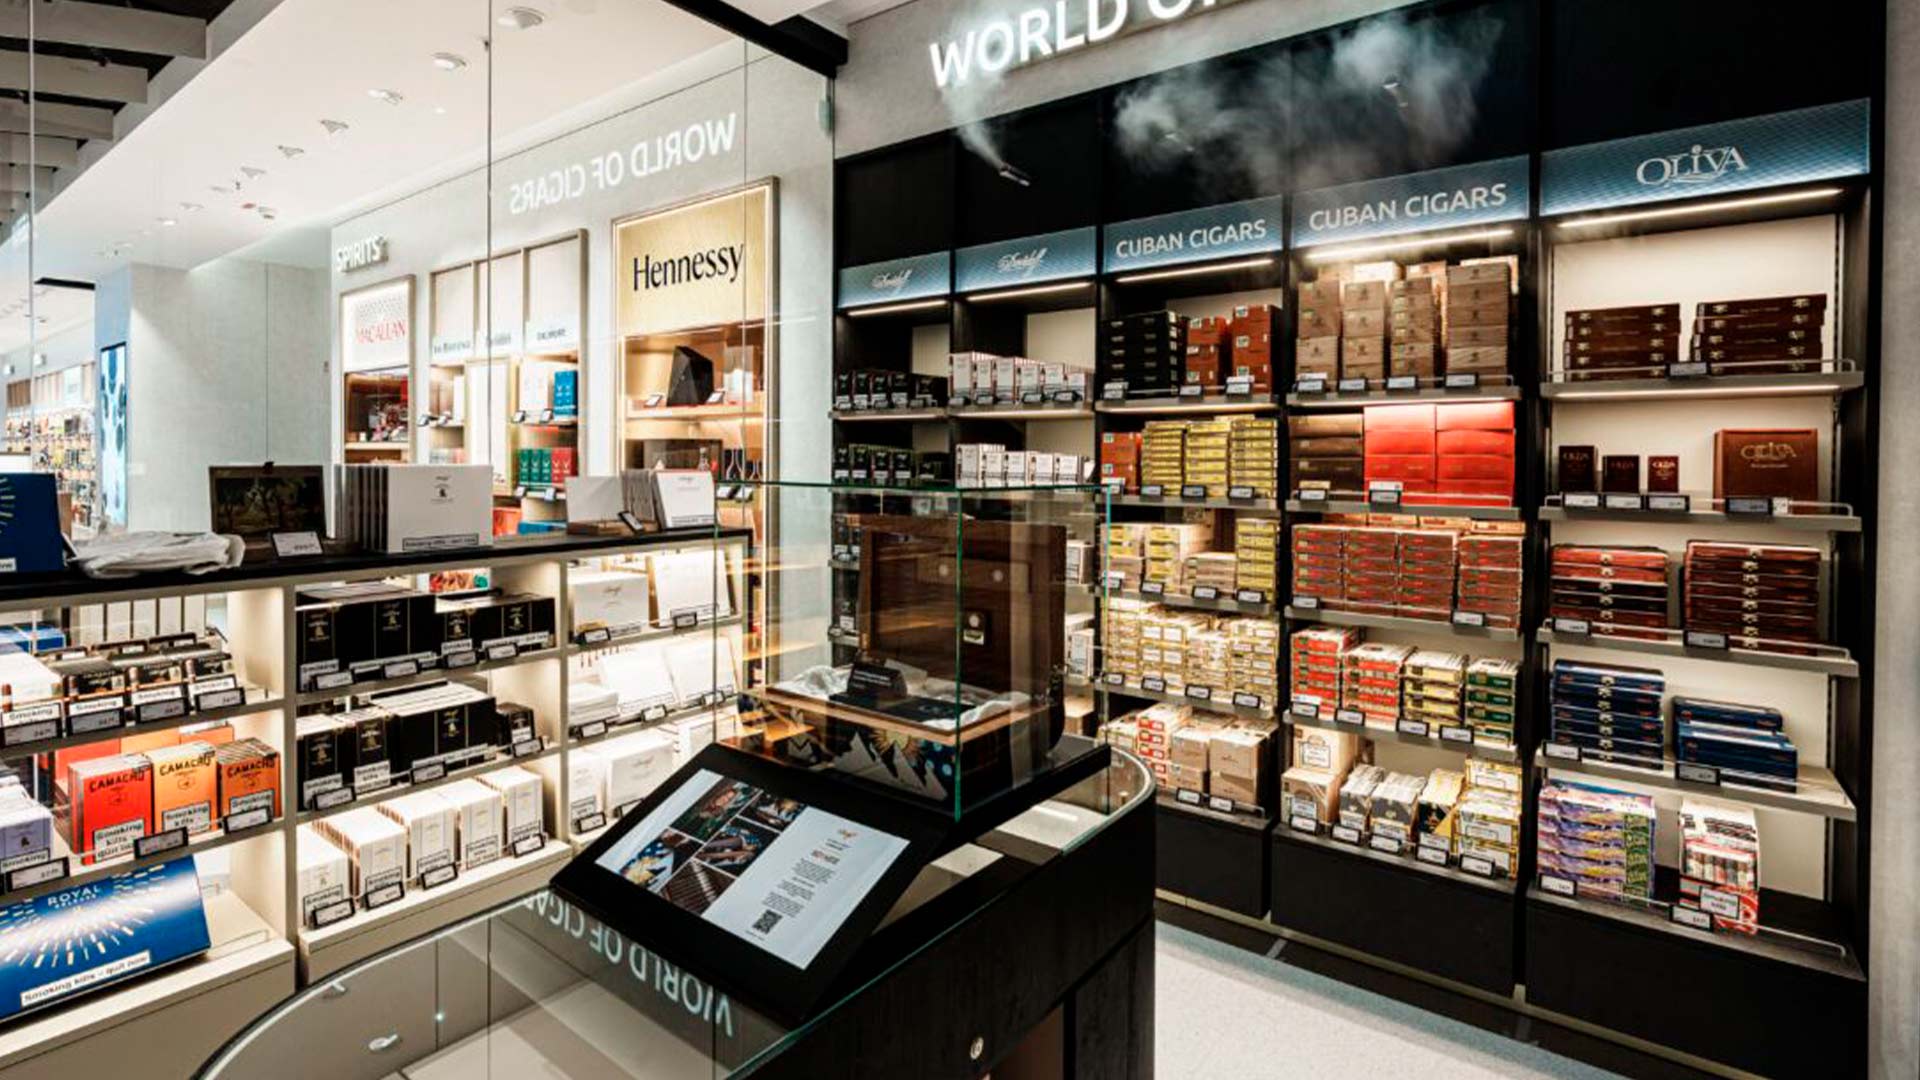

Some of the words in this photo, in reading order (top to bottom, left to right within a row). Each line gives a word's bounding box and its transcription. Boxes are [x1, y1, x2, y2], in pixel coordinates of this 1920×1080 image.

[928, 0, 1128, 88] WORLD
[1309, 200, 1396, 231] CUBAN
[1405, 183, 1507, 218] CIGARS
[336, 233, 385, 273] SPIRITS
[1116, 233, 1182, 258] CUBAN
[1188, 220, 1267, 247] CIGARS
[632, 242, 744, 292] Hennessy
[47, 885, 101, 907] ROYAL
[24, 983, 73, 1001] Smoking
